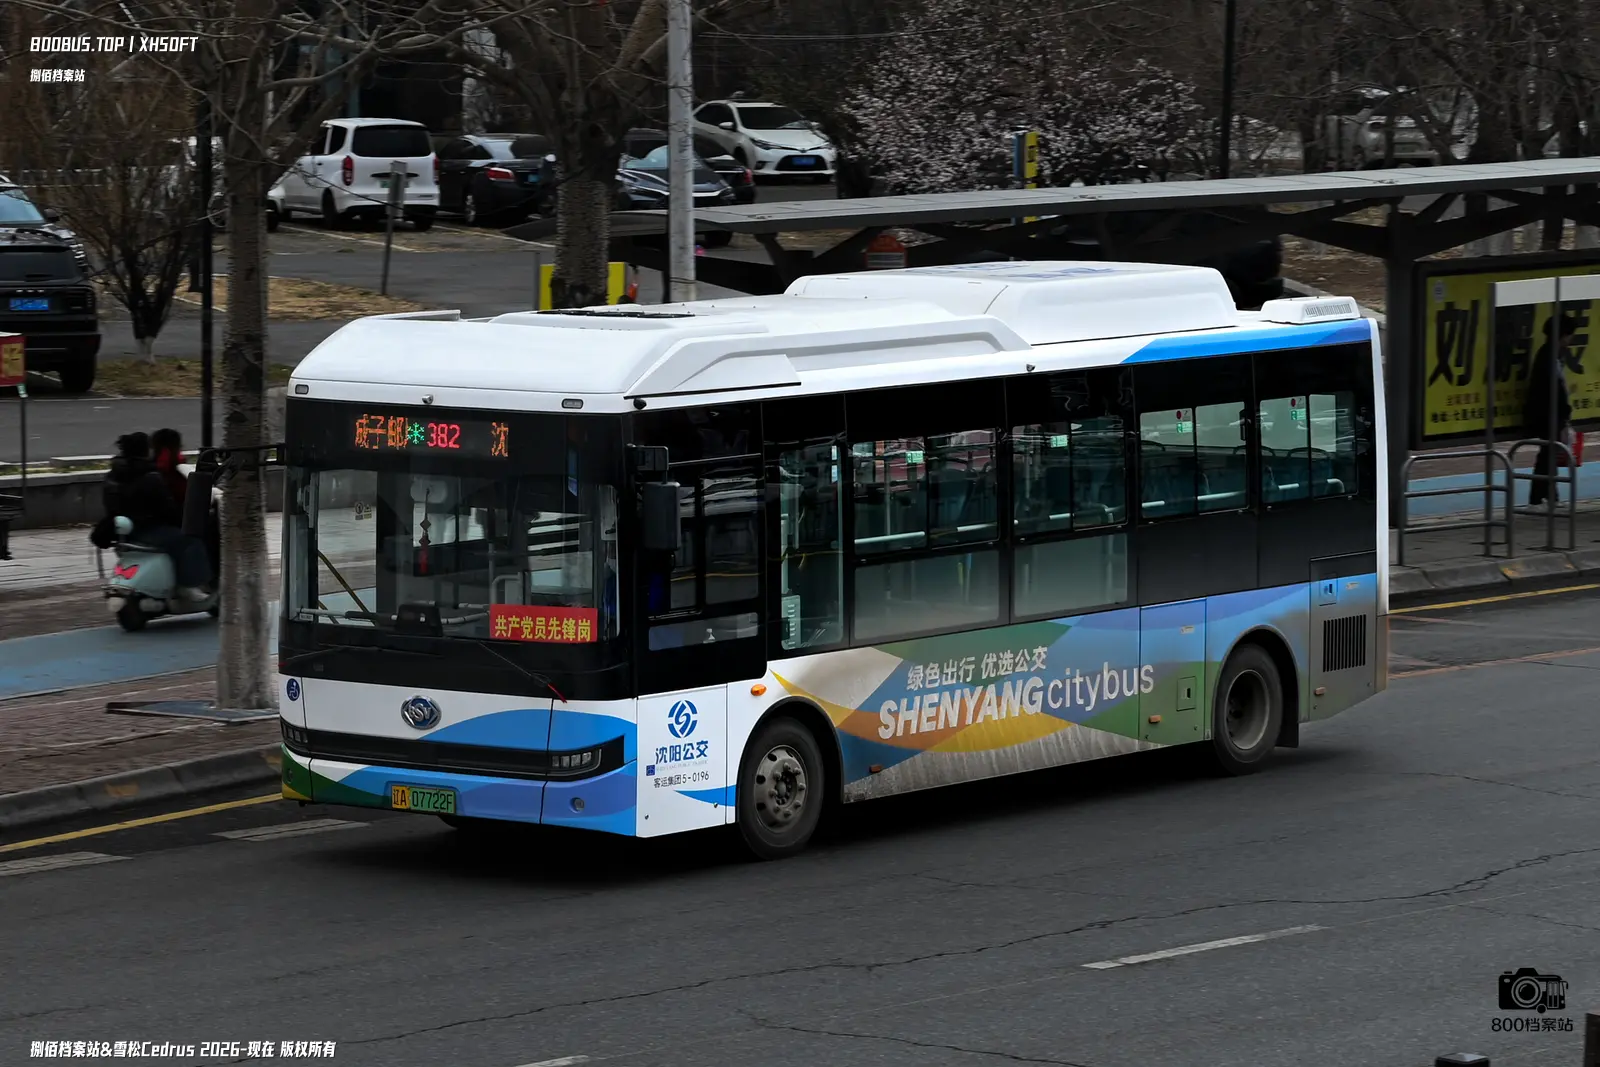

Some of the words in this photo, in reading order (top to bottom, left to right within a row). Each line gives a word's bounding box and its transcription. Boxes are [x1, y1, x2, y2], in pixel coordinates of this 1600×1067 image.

[427, 422, 460, 448] 382
[495, 615, 591, 642] 共产党员先锋岗
[906, 657, 975, 691] 绿色出行
[981, 646, 1048, 680] 优选公交
[878, 677, 1043, 740] SHENYANG
[1047, 661, 1154, 711] citybus
[655, 740, 708, 764] 沈阳公交
[412, 790, 452, 811] 07722F
